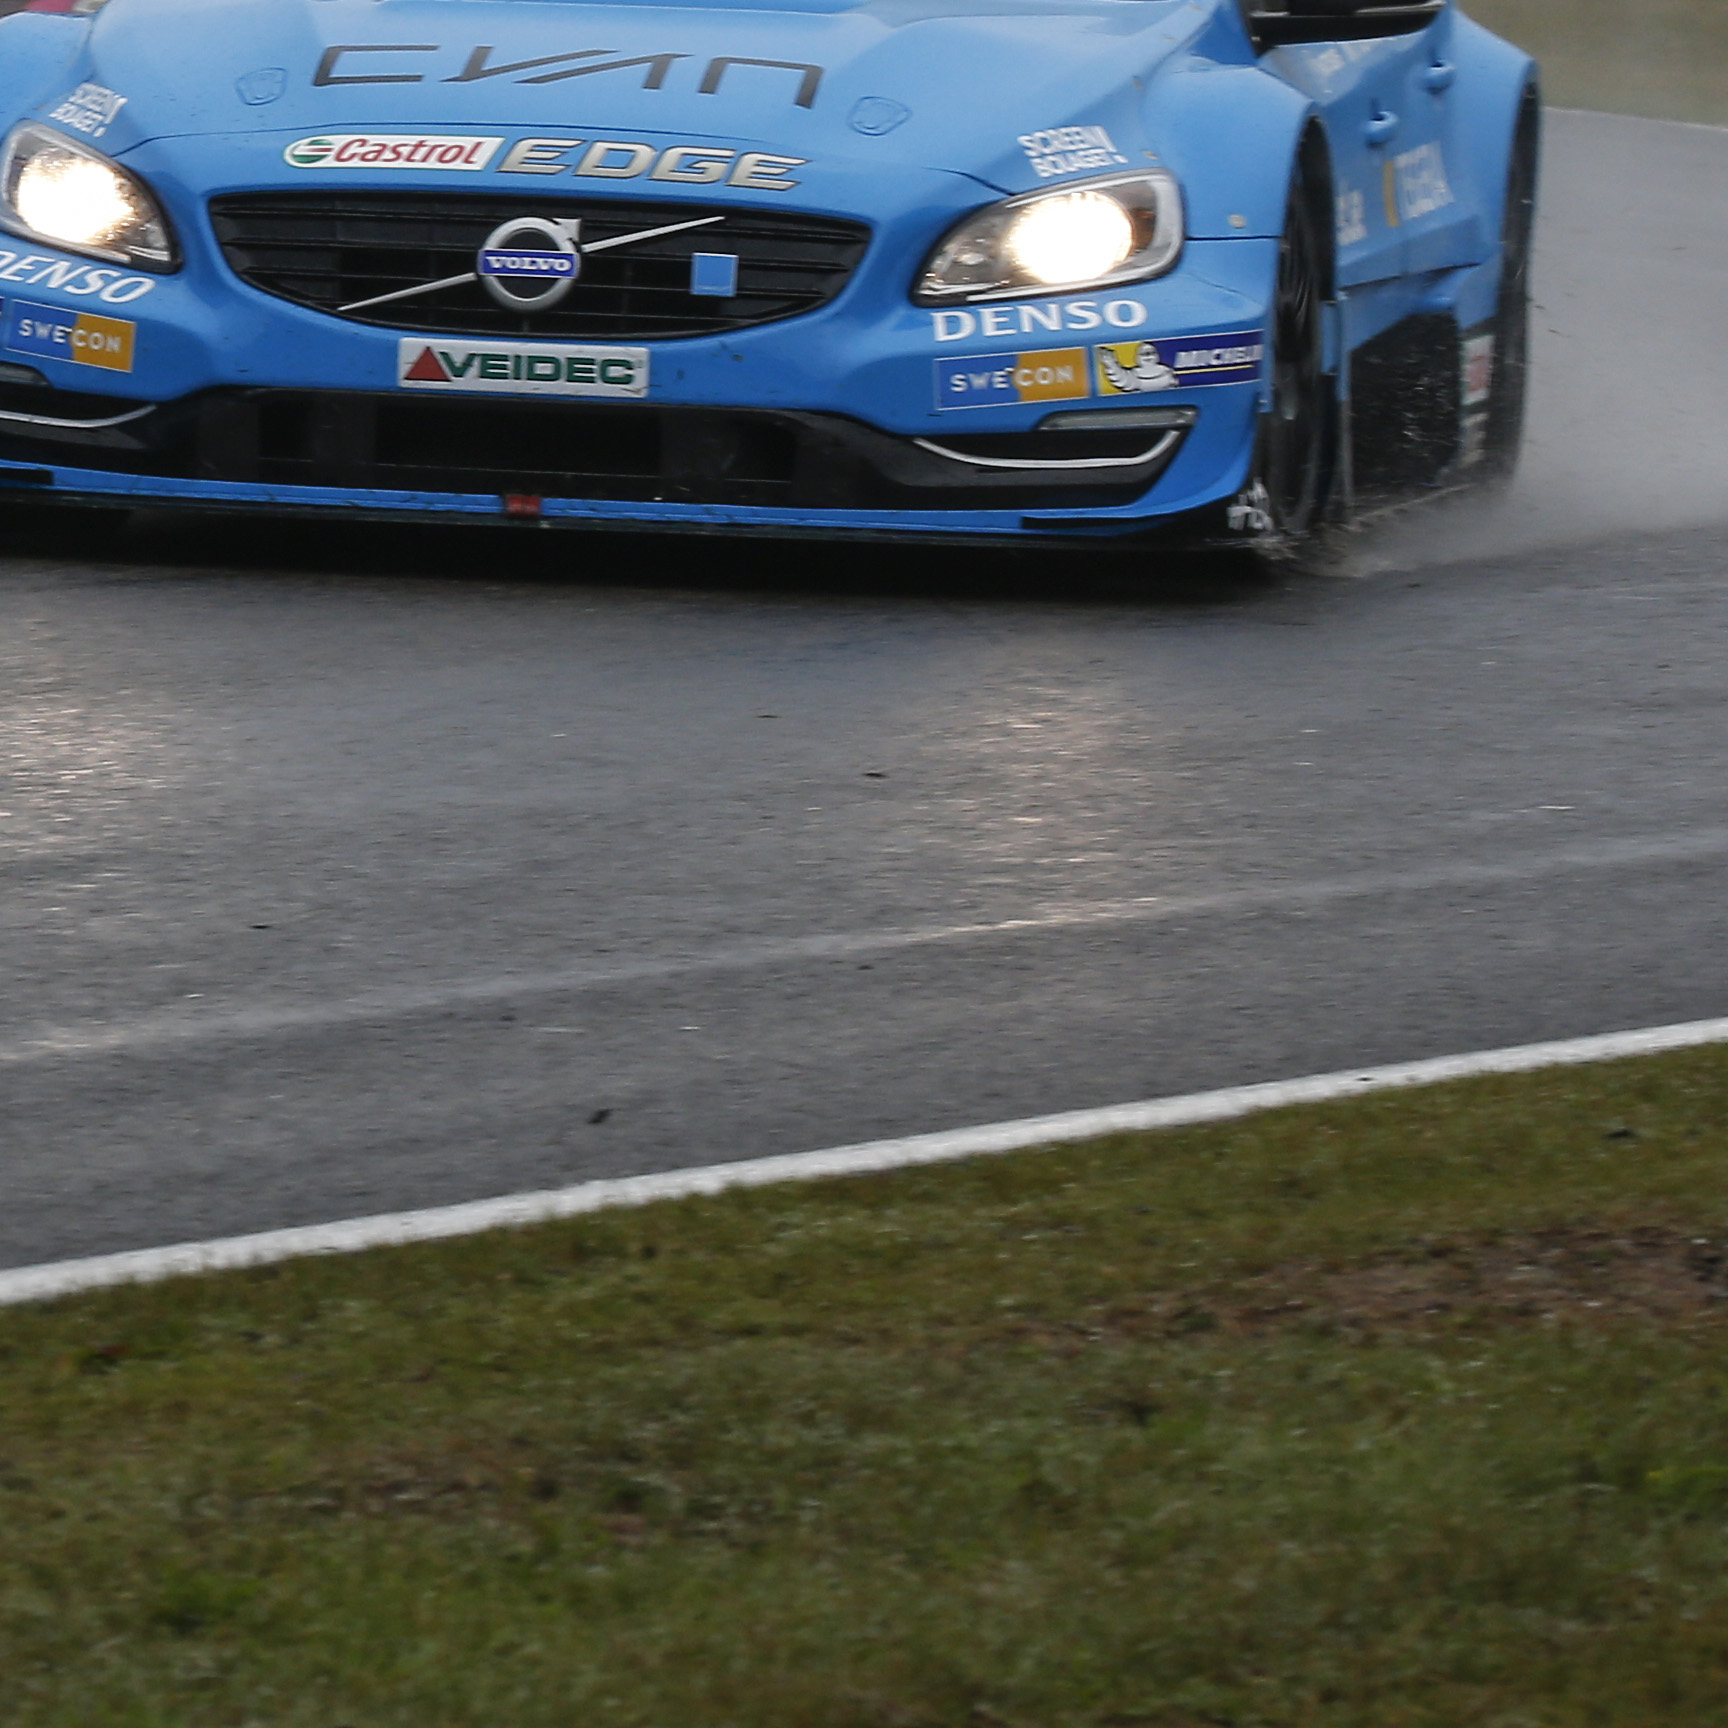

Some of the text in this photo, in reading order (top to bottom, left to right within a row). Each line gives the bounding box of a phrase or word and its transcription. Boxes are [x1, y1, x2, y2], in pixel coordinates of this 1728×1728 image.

[334, 137, 813, 191] Castrol EDGE
[486, 255, 573, 272] VOLVO
[930, 299, 1148, 342] DENSO
[440, 351, 635, 386] VEIDEC
